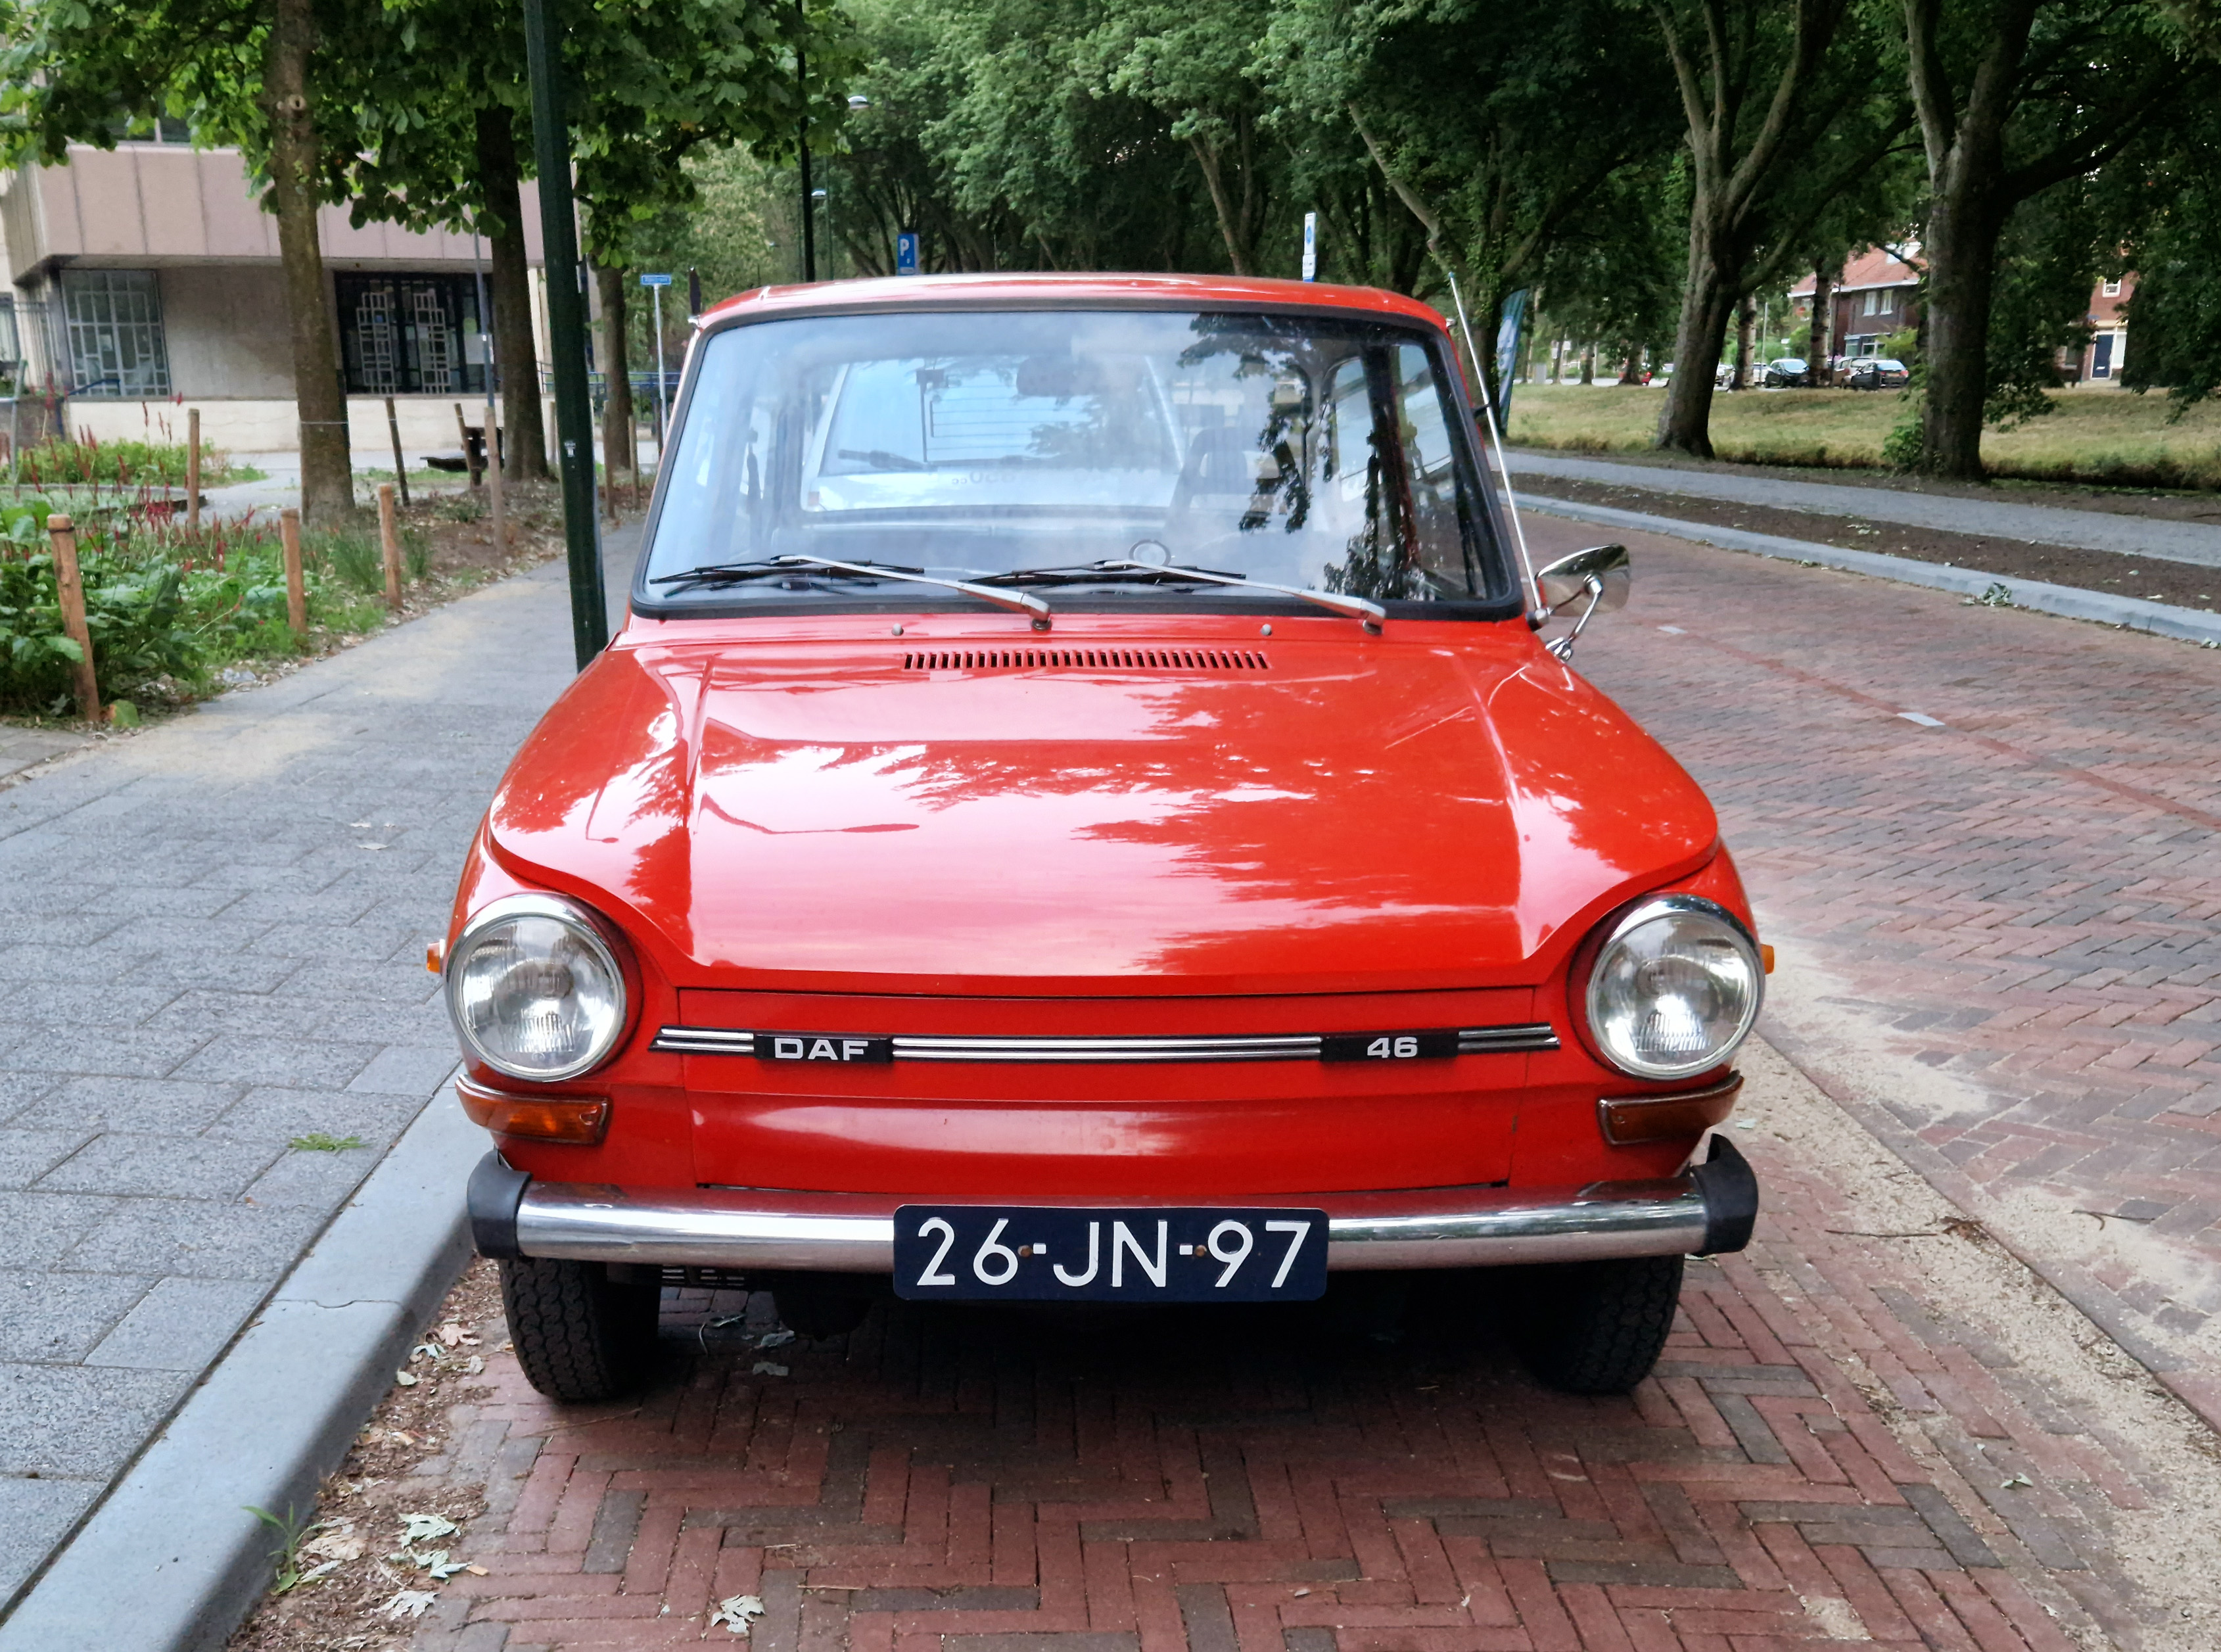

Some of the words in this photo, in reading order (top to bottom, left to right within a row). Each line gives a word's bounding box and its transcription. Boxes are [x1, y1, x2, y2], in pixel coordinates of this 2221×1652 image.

[900, 239, 910, 256] P
[774, 1037, 868, 1061] DAF
[1367, 1036, 1418, 1058] 46
[917, 1217, 1311, 1288] 26-JN-97
